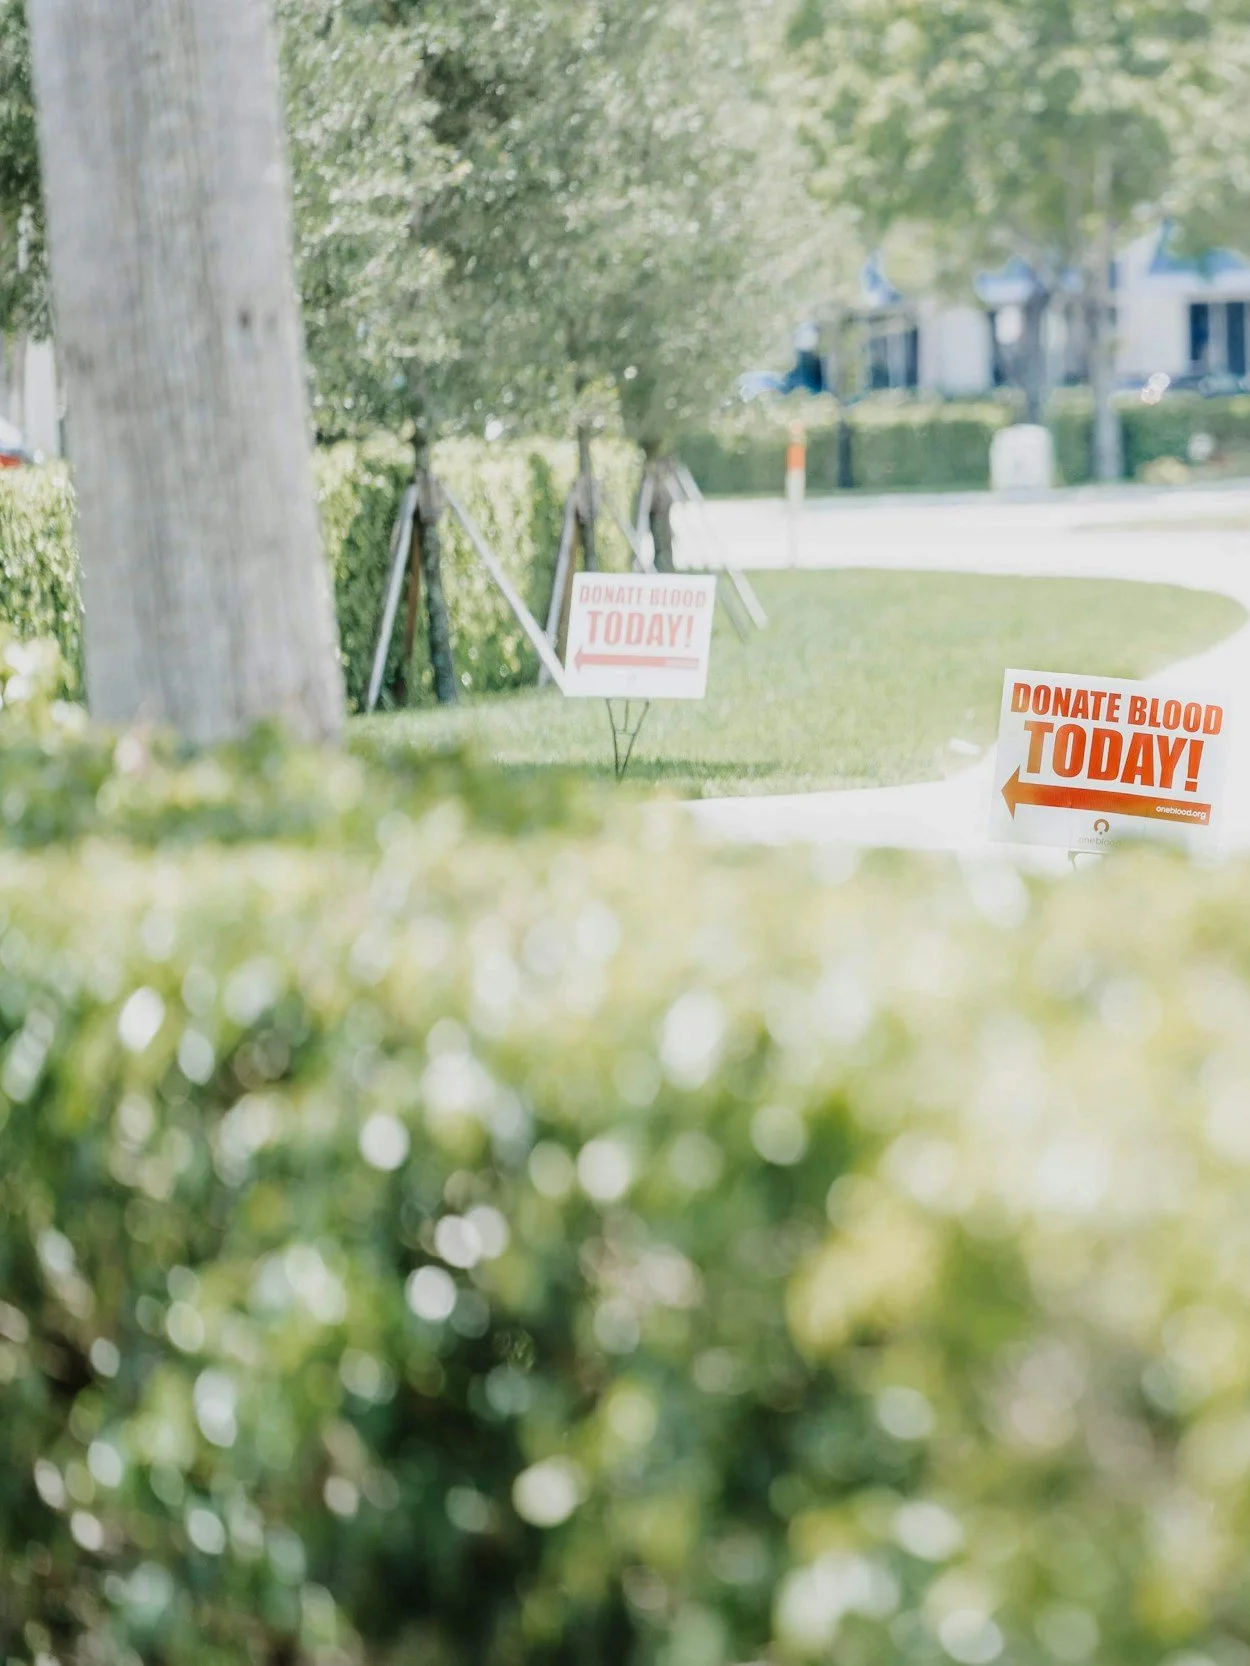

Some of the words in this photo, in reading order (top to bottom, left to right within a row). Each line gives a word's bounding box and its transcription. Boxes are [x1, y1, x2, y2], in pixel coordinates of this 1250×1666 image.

[579, 585, 643, 605] DONATE
[650, 588, 707, 608] BLOOD
[587, 610, 694, 648] TODAY!
[1011, 682, 1121, 723] DONATE
[1127, 695, 1224, 735] BLOOD
[1024, 720, 1204, 792] TODAY!
[1155, 806, 1206, 820] oneblood.org
